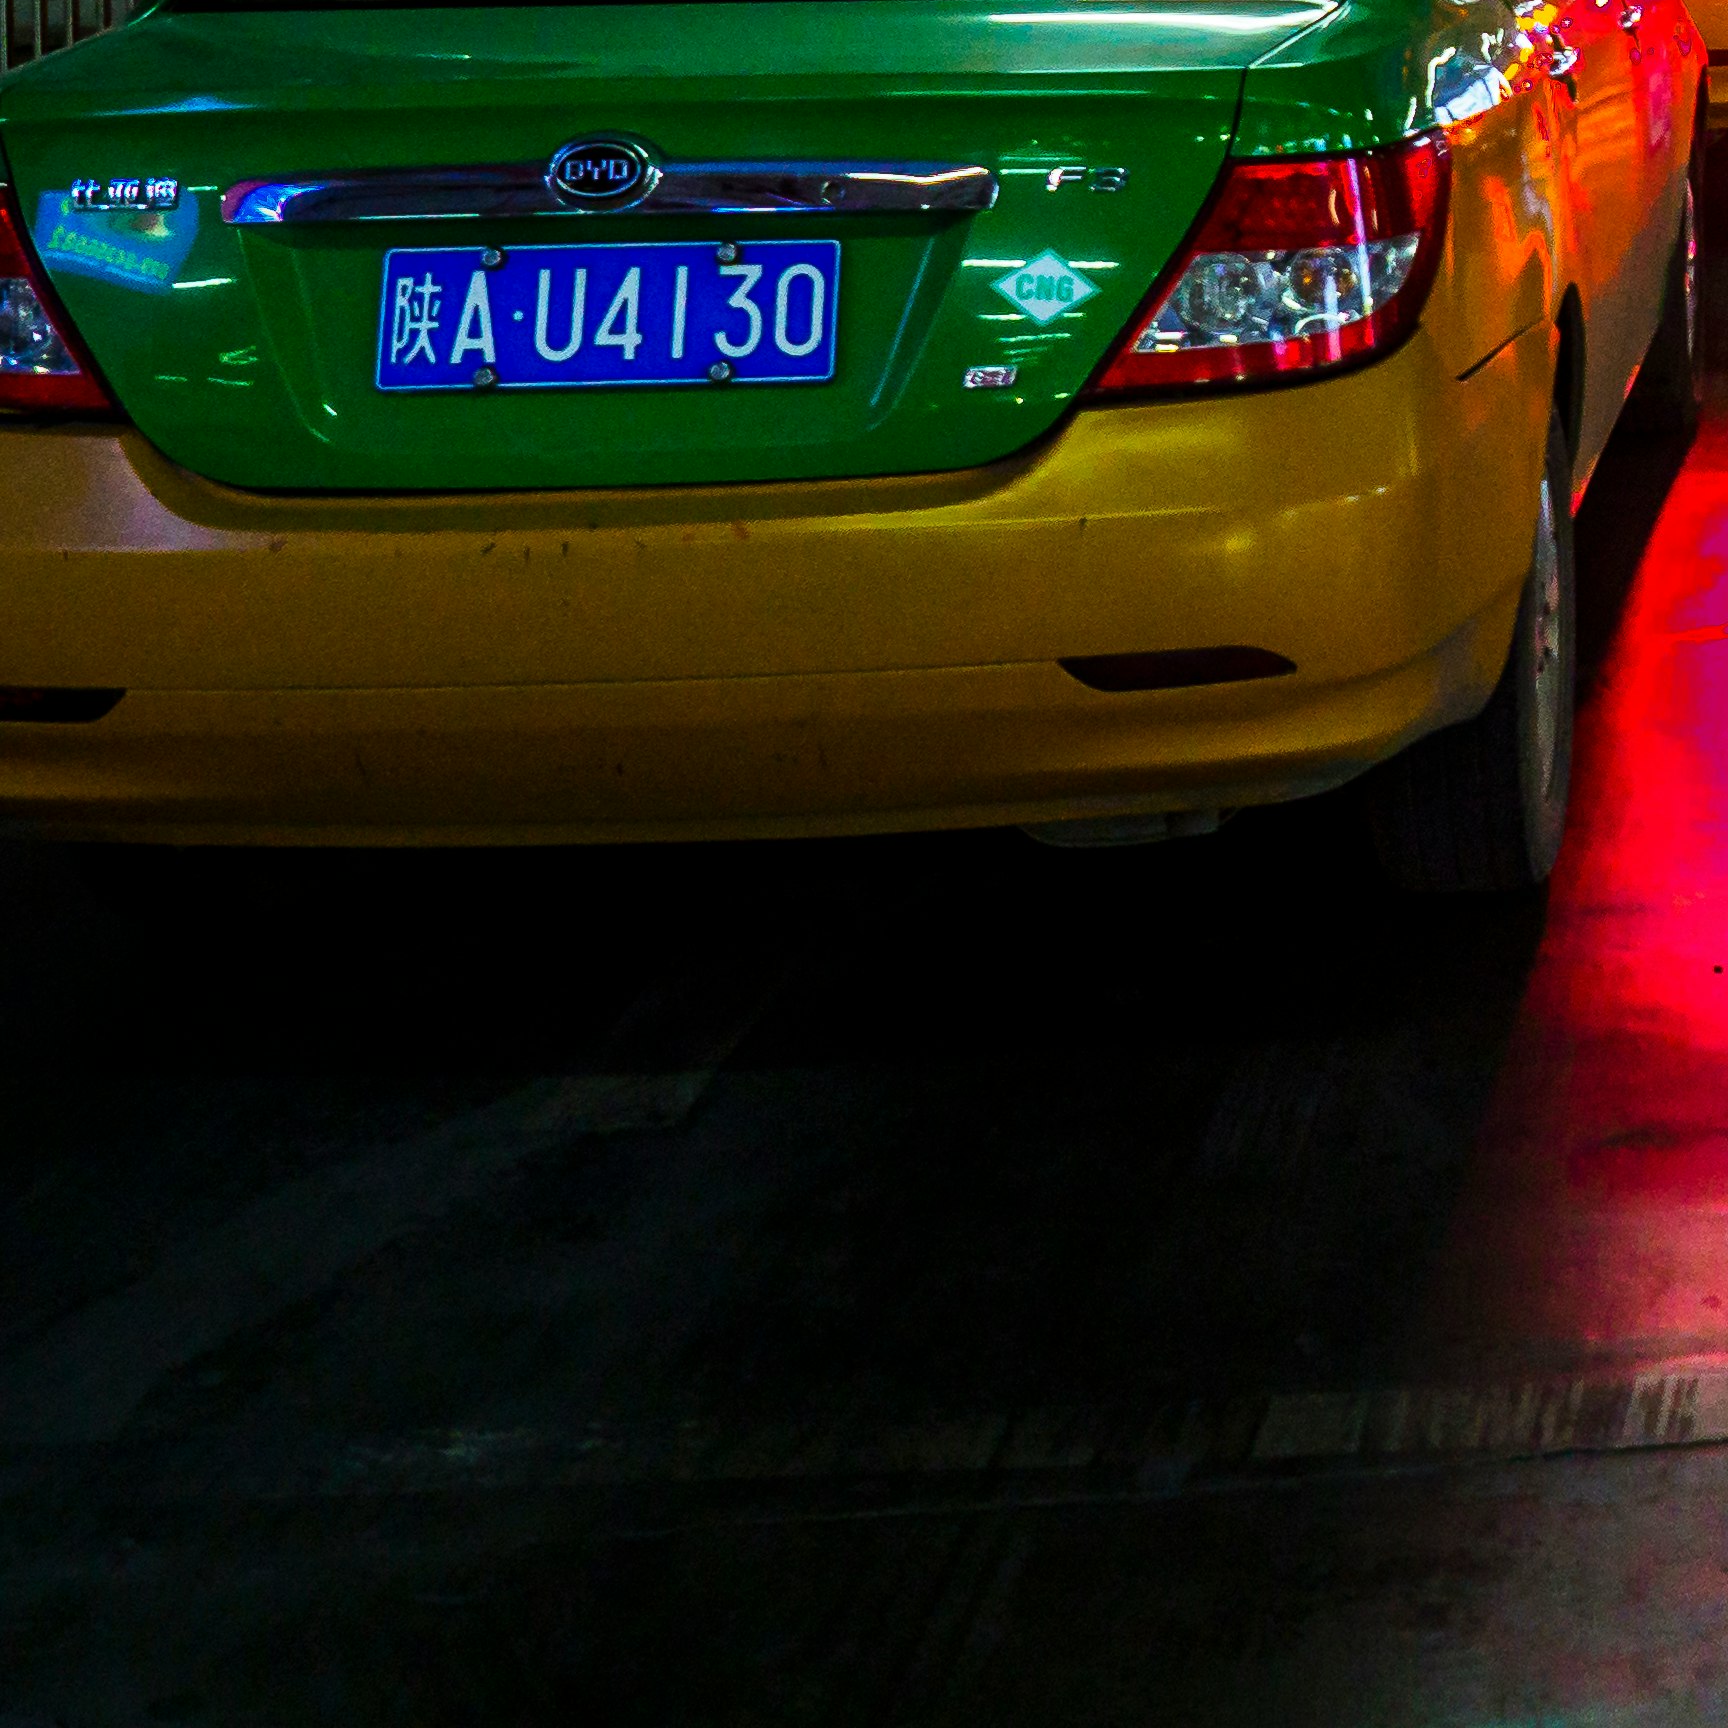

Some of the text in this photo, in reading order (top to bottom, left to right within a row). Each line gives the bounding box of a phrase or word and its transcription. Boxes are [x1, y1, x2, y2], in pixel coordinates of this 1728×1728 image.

[564, 158, 629, 181] BYD
[1046, 165, 1131, 193] F3
[1014, 272, 1075, 303] CNG
